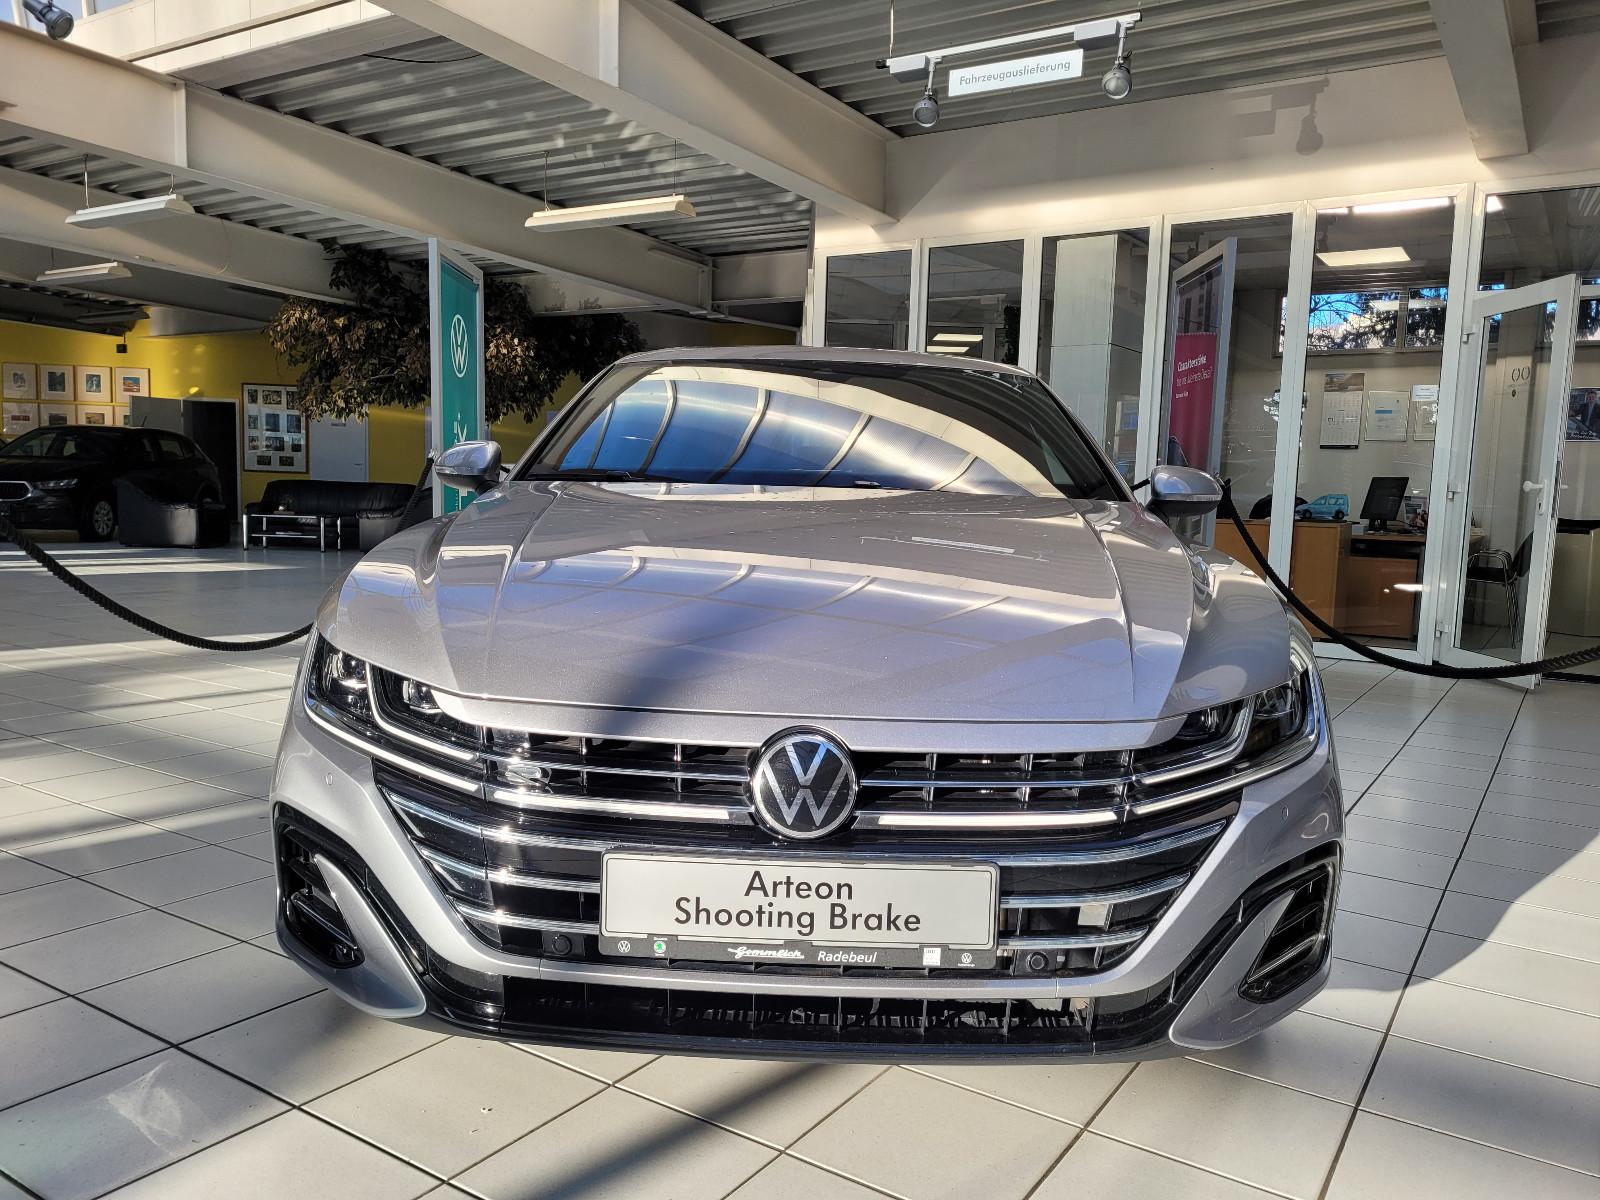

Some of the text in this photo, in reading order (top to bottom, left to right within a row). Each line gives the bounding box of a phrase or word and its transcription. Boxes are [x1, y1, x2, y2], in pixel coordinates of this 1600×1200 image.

[959, 61, 1071, 86] Fahrzeugauslieferung
[744, 870, 853, 901] Arteon
[674, 896, 922, 936] Shooting Brake
[817, 950, 878, 964] Radebeul
